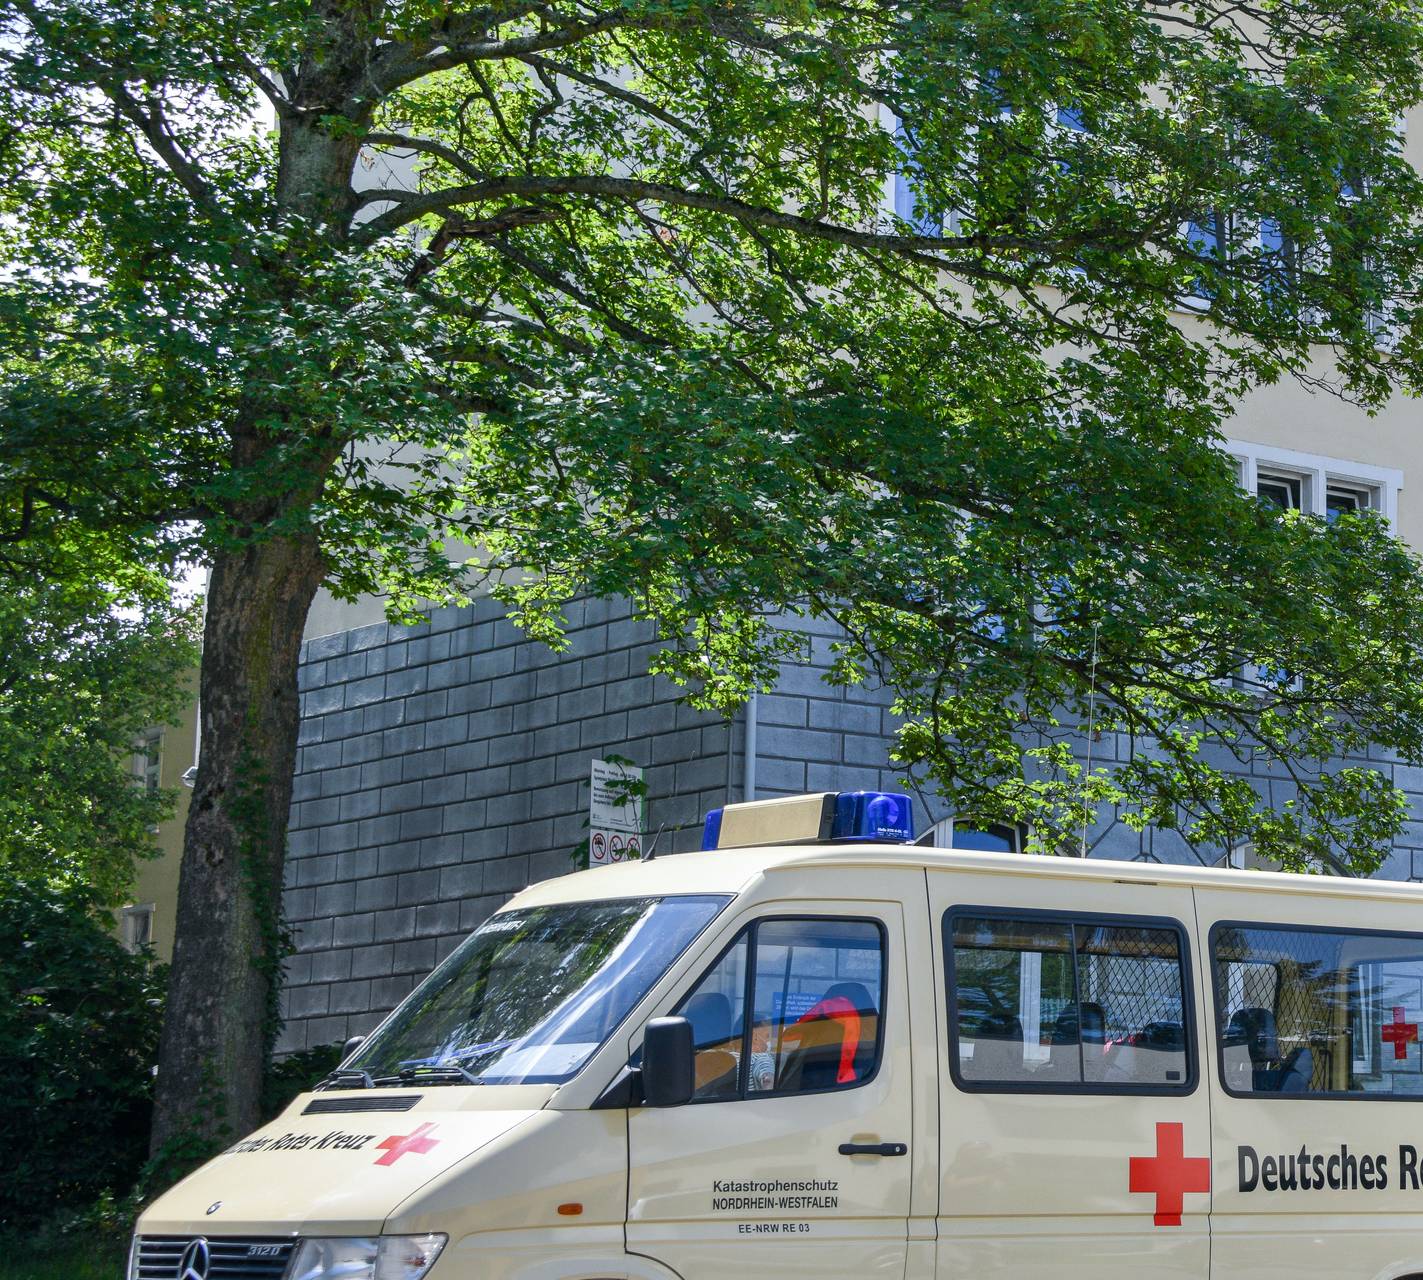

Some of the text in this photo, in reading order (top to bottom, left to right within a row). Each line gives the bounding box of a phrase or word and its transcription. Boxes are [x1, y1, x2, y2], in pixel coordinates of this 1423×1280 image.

[264, 1133, 318, 1151] Rotes
[309, 1131, 377, 1150] Kreuz
[1237, 1144, 1388, 1192] Deutsches
[713, 1179, 839, 1194] Katastrophenschutz
[712, 1197, 838, 1210] NORDRHEIN-WESTFALEN
[738, 1224, 810, 1234] EE-NRW RE 03
